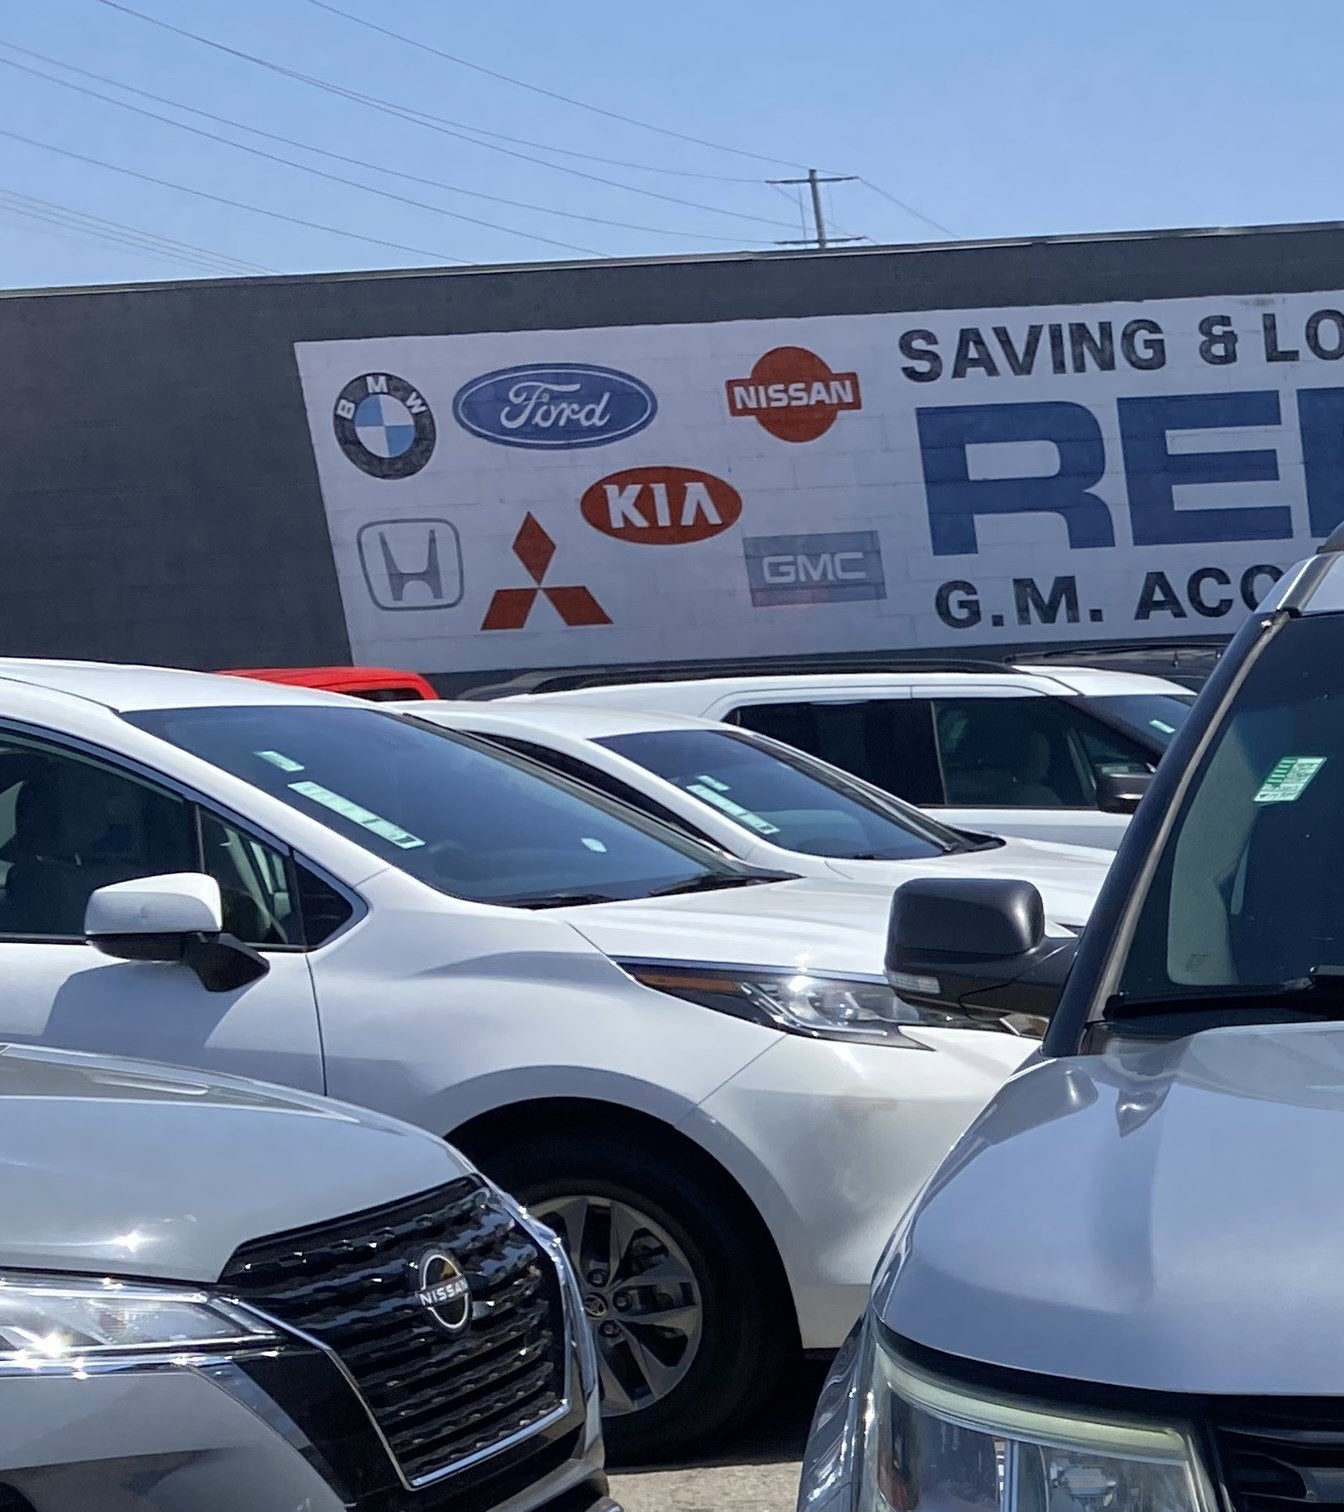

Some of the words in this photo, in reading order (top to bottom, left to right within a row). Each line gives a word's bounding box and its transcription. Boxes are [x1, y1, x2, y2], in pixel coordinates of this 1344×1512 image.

[899, 318, 1167, 382] SAVING
[1199, 315, 1239, 366] &
[335, 375, 428, 420] BMW
[500, 381, 611, 429] Ford
[733, 378, 854, 410] NISSAN
[603, 481, 723, 530] KIA
[762, 551, 867, 583] GMC
[934, 575, 1103, 629] G.M.
[420, 1279, 468, 1306] NISSAN
